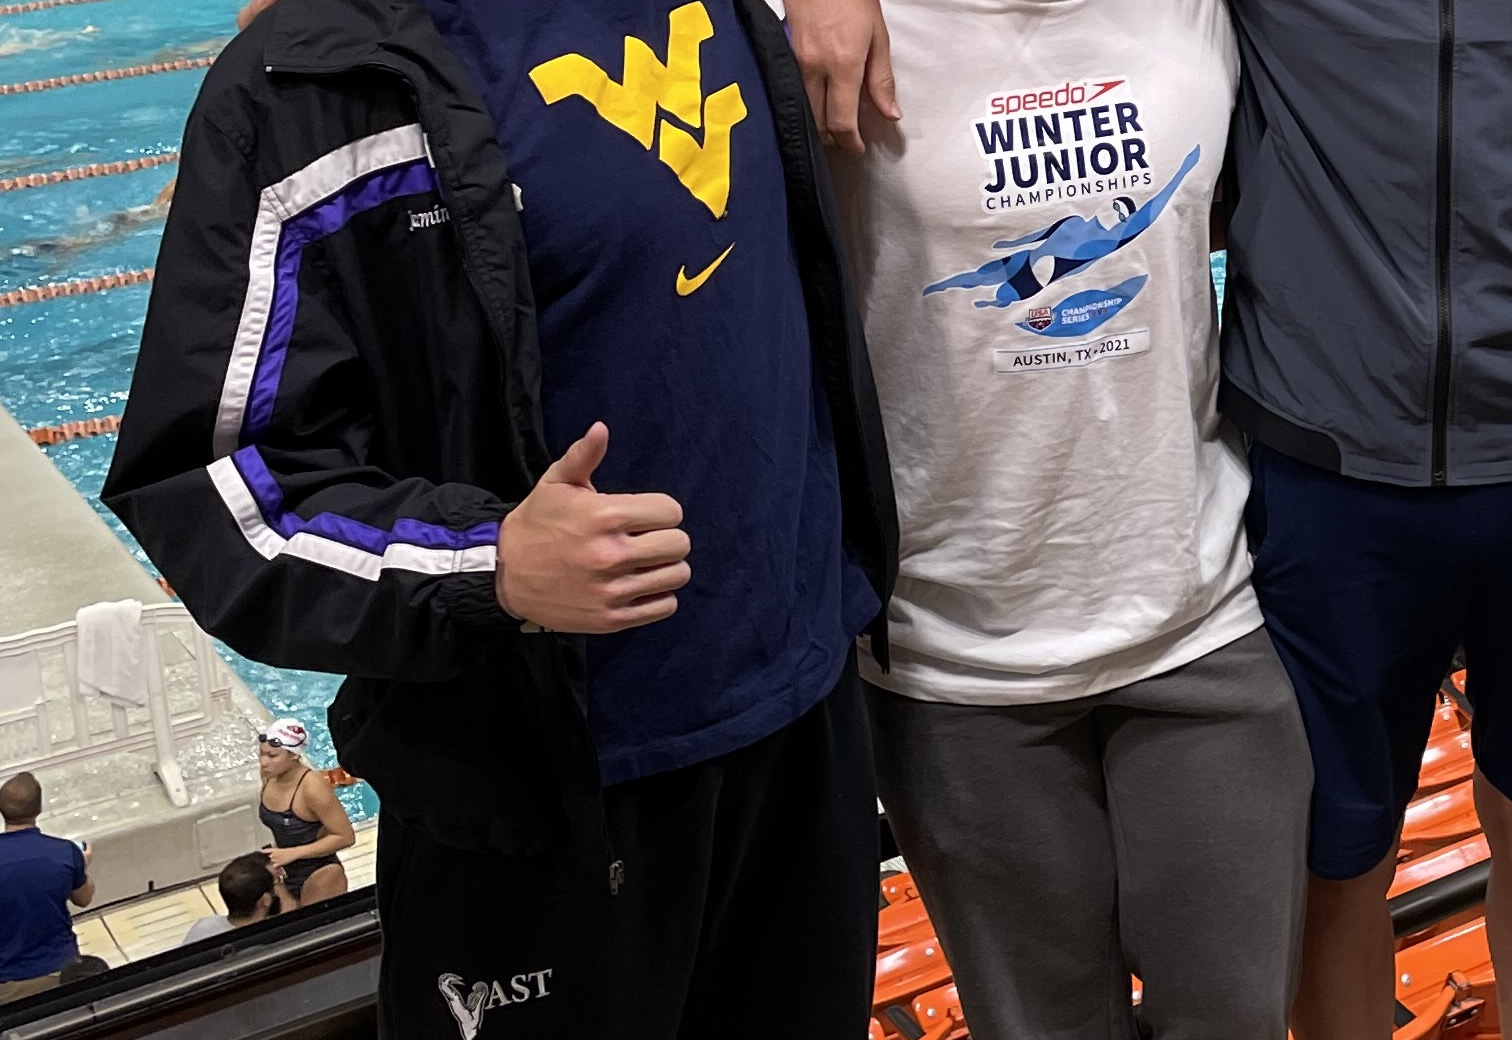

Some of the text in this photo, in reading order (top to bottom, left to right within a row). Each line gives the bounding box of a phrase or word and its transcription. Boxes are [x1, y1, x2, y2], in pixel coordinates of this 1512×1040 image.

[990, 82, 1088, 115] speedo
[975, 101, 1144, 155] WINTER
[984, 138, 1150, 193] JUNIOR
[985, 172, 1152, 210] CHAMPIONSHIPS
[1061, 297, 1123, 317] CHAMPIONSHIP
[1061, 313, 1090, 325] SERIES
[1013, 351, 1072, 368] AUSTIN,
